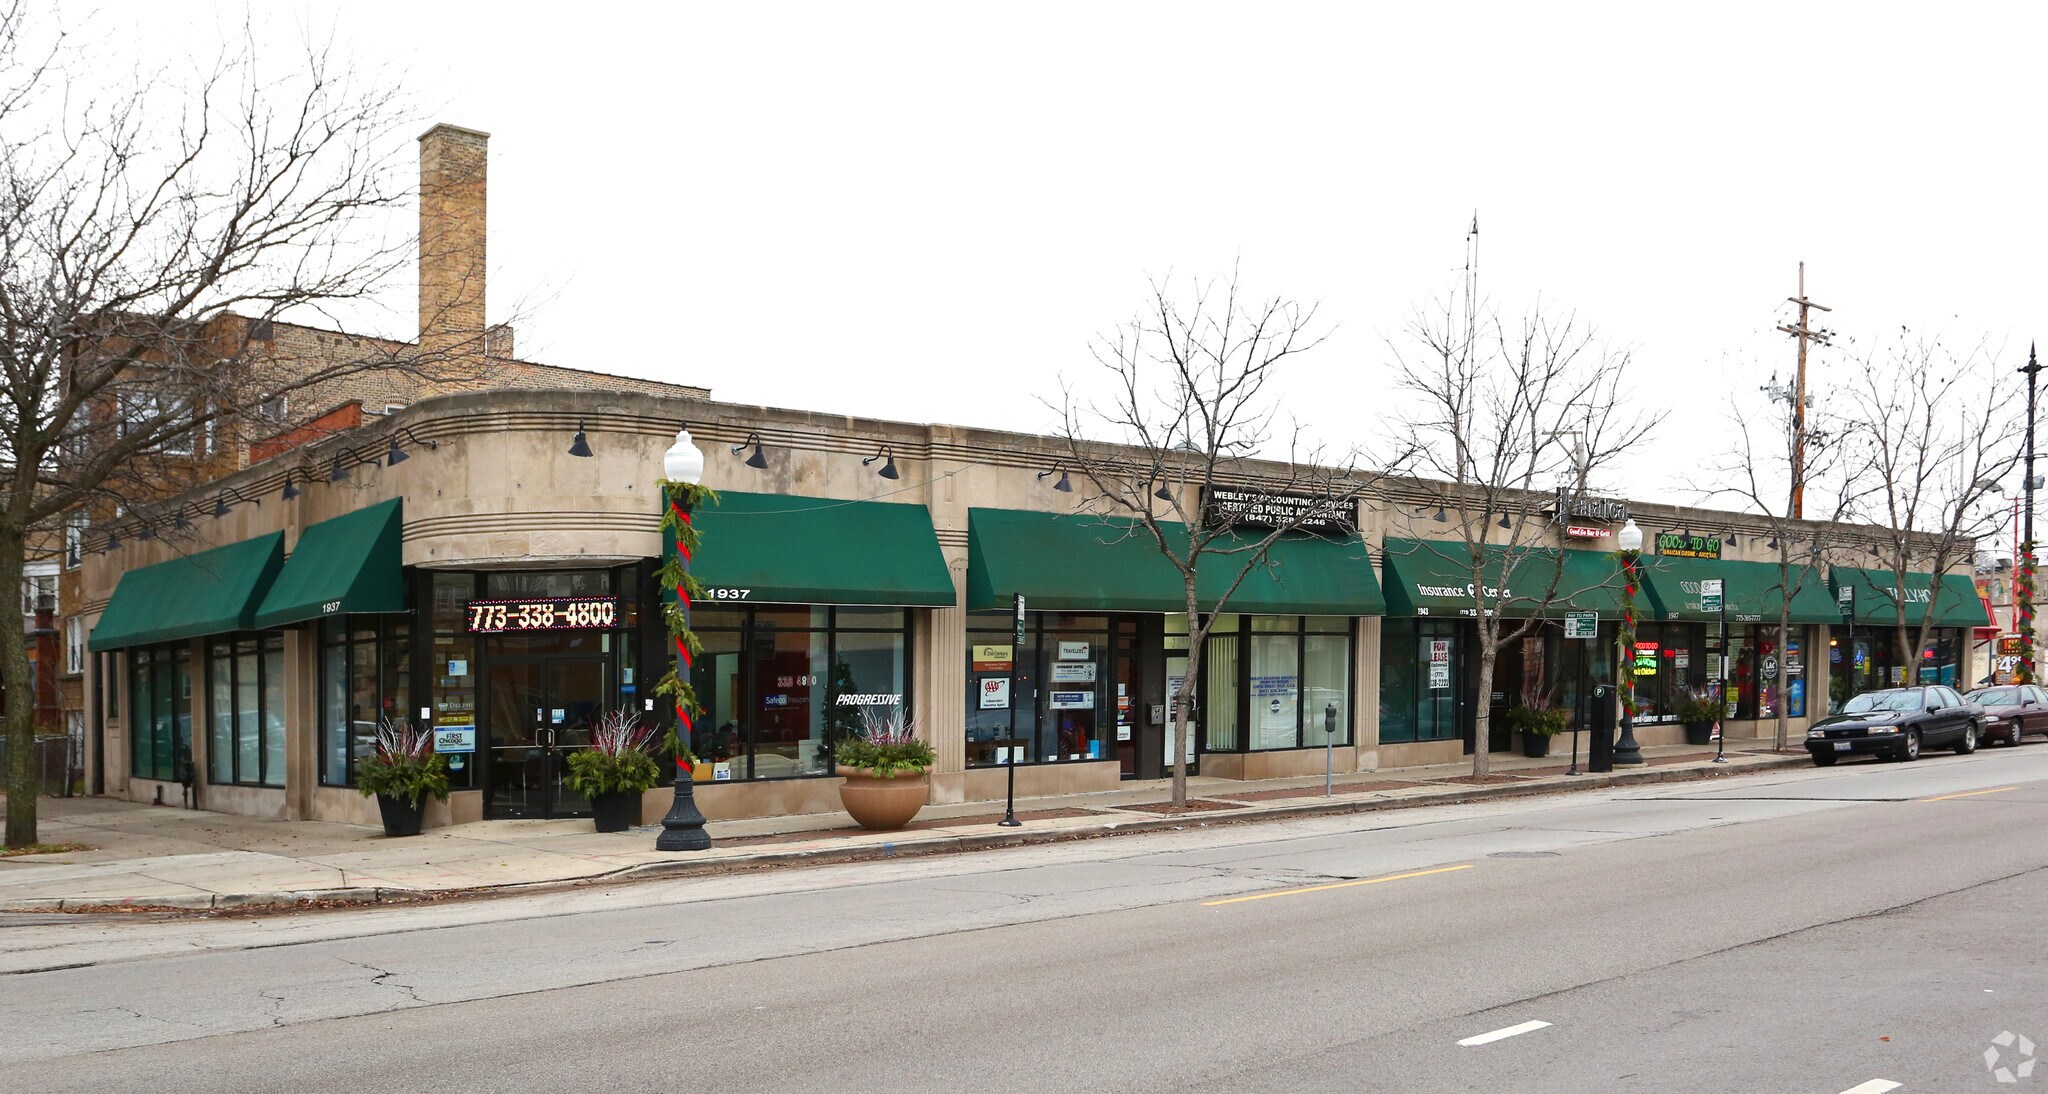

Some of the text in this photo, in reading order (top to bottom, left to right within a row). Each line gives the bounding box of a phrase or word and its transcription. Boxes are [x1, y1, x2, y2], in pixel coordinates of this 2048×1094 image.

[1245, 513, 1273, 523] (847)
[1296, 509, 1347, 520] ACOUNTANT
[1690, 537, 1703, 550] TO
[1707, 538, 1720, 552] GO
[708, 588, 751, 599] 1937
[1416, 584, 1465, 597] Insurance
[1482, 586, 1511, 598] Cener
[1680, 581, 1702, 594] GOO
[1886, 587, 1932, 603] TALY-HO
[322, 601, 341, 614] 1937
[1417, 607, 1429, 616] 1943
[471, 601, 614, 630] 773-338-4800
[1433, 642, 1446, 651] FOR
[1430, 652, 1448, 662] LEASE
[835, 694, 902, 706] PROGRESSIVE
